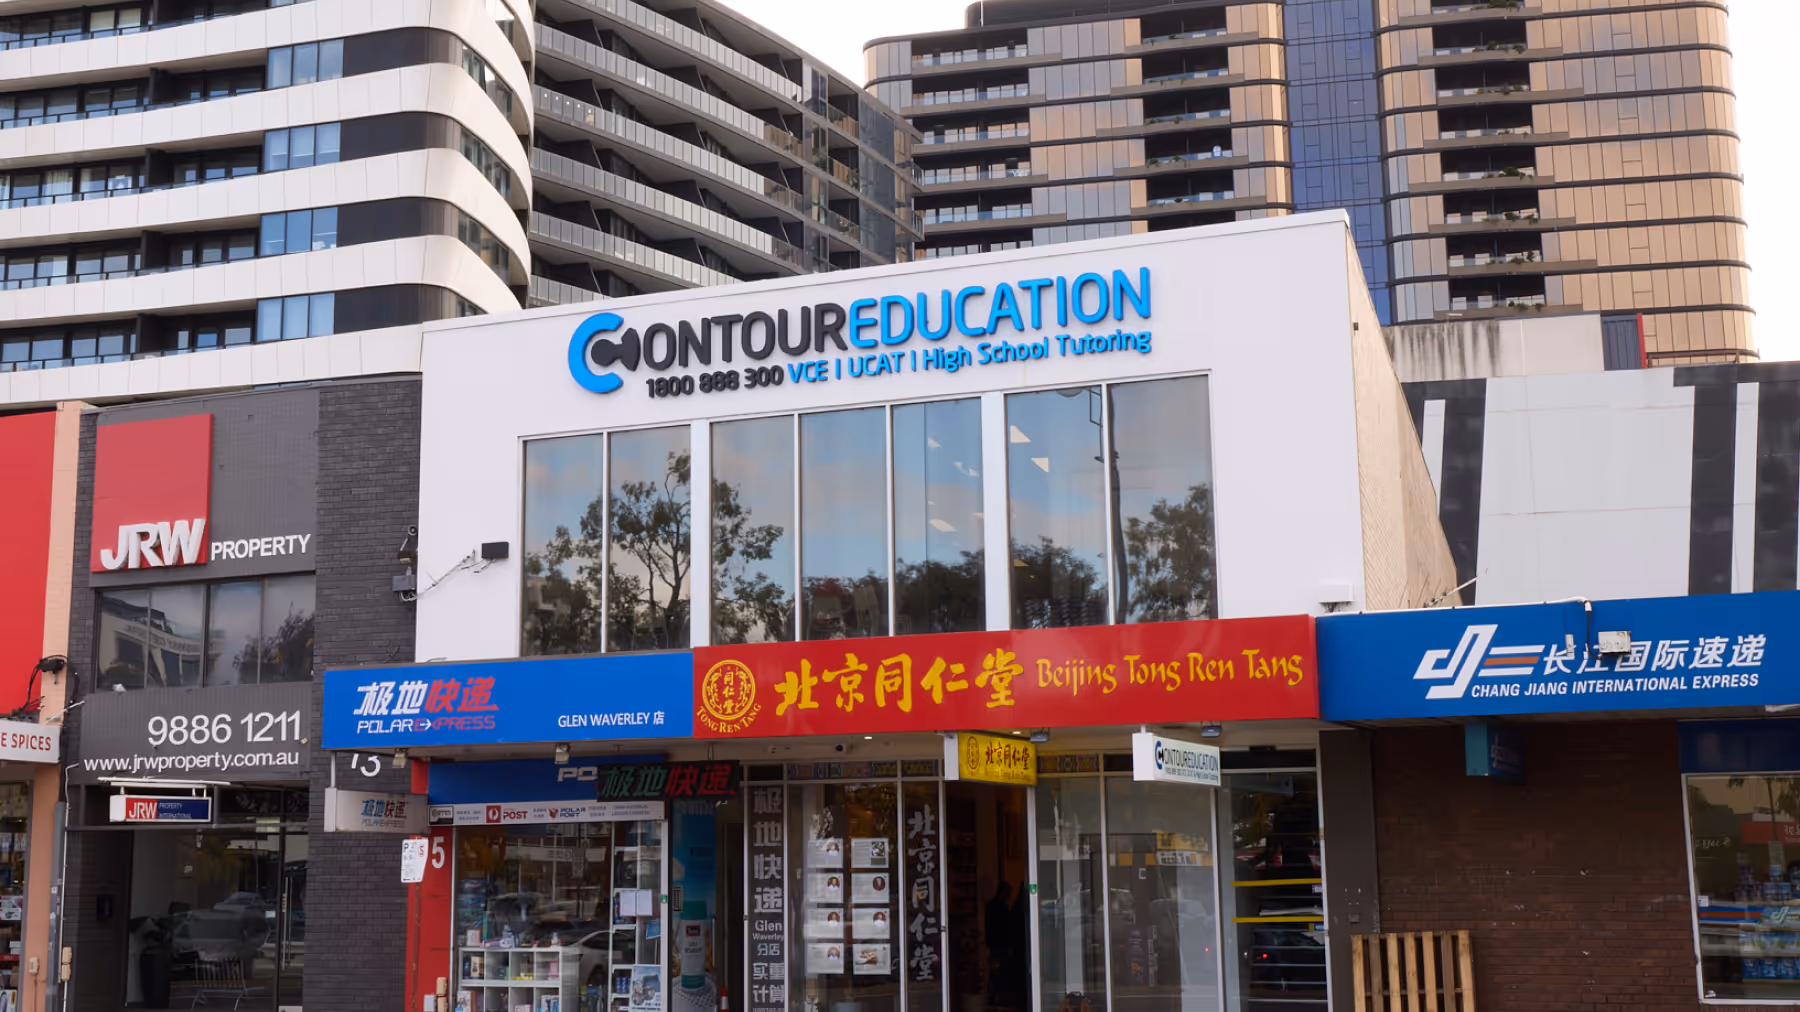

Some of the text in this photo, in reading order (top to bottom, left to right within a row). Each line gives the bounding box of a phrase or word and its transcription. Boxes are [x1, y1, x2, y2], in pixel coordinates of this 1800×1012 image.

[645, 375, 694, 398] 1800
[699, 370, 740, 393] 888
[743, 364, 784, 389] 300
[787, 359, 828, 383] VCE
[848, 351, 904, 378] UCAT
[923, 345, 972, 372] High
[977, 336, 1049, 365] School
[1055, 328, 1152, 356] Tutoring
[100, 518, 312, 570] JRW PROPERTY
[774, 648, 1024, 716] 北京同仁堂
[1036, 649, 1303, 696] Beijing Tong Ren Tang
[1471, 673, 1759, 699] CHANG JIANG INTERNATIONAL EXPRESS
[353, 676, 500, 716] 极地快递
[148, 709, 301, 746] 9886 1211
[558, 711, 665, 728] GLEN WAVERLEY 店
[696, 703, 761, 733] TONG REN TANG
[11, 734, 52, 752] SPICES
[84, 750, 299, 774] www.jrwproperty.com.au
[600, 764, 736, 798] 极地快递
[129, 802, 157, 818] JRW
[503, 811, 528, 820] POST
[753, 787, 783, 913] 极地快递
[752, 933, 784, 942] Waverley
[754, 920, 782, 932] Glen
[757, 943, 780, 956] 分店
